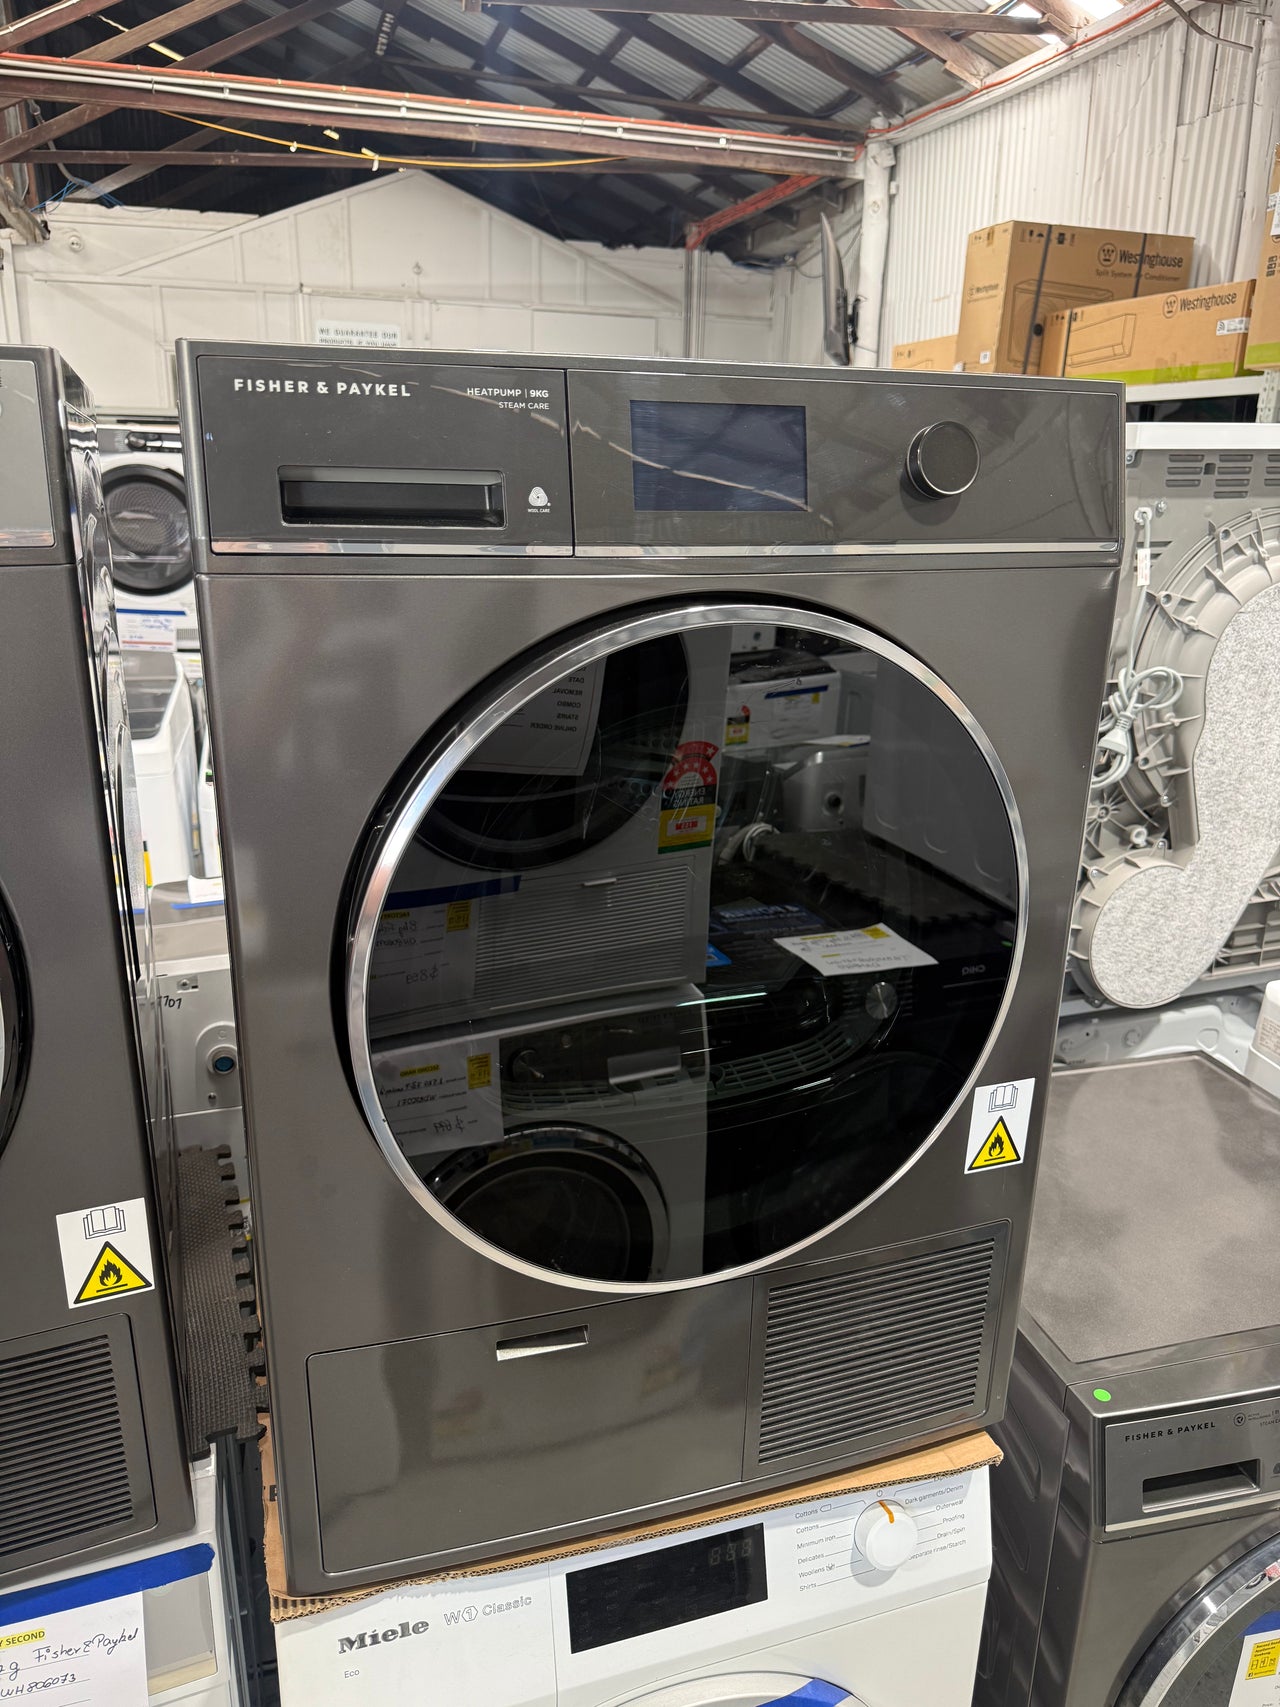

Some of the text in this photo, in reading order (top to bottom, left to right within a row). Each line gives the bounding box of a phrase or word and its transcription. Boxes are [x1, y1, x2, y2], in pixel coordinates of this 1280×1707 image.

[1180, 292, 1237, 311] Westinghouse
[234, 379, 411, 397] FISHER & PAYKEL
[467, 387, 521, 397] HEATPUMP
[530, 390, 549, 398] 9KG
[499, 401, 550, 410] STEAM CARE
[1125, 1422, 1216, 1442] FISHER & PAYKEL
[795, 1509, 818, 1519] Cottons
[796, 1524, 819, 1534] Cottons
[799, 1582, 817, 1592] Shirts
[482, 1596, 532, 1616] Classic
[5, 1630, 46, 1646] SECOND
[337, 1619, 430, 1654] Miele
[344, 1669, 360, 1679] Eco
